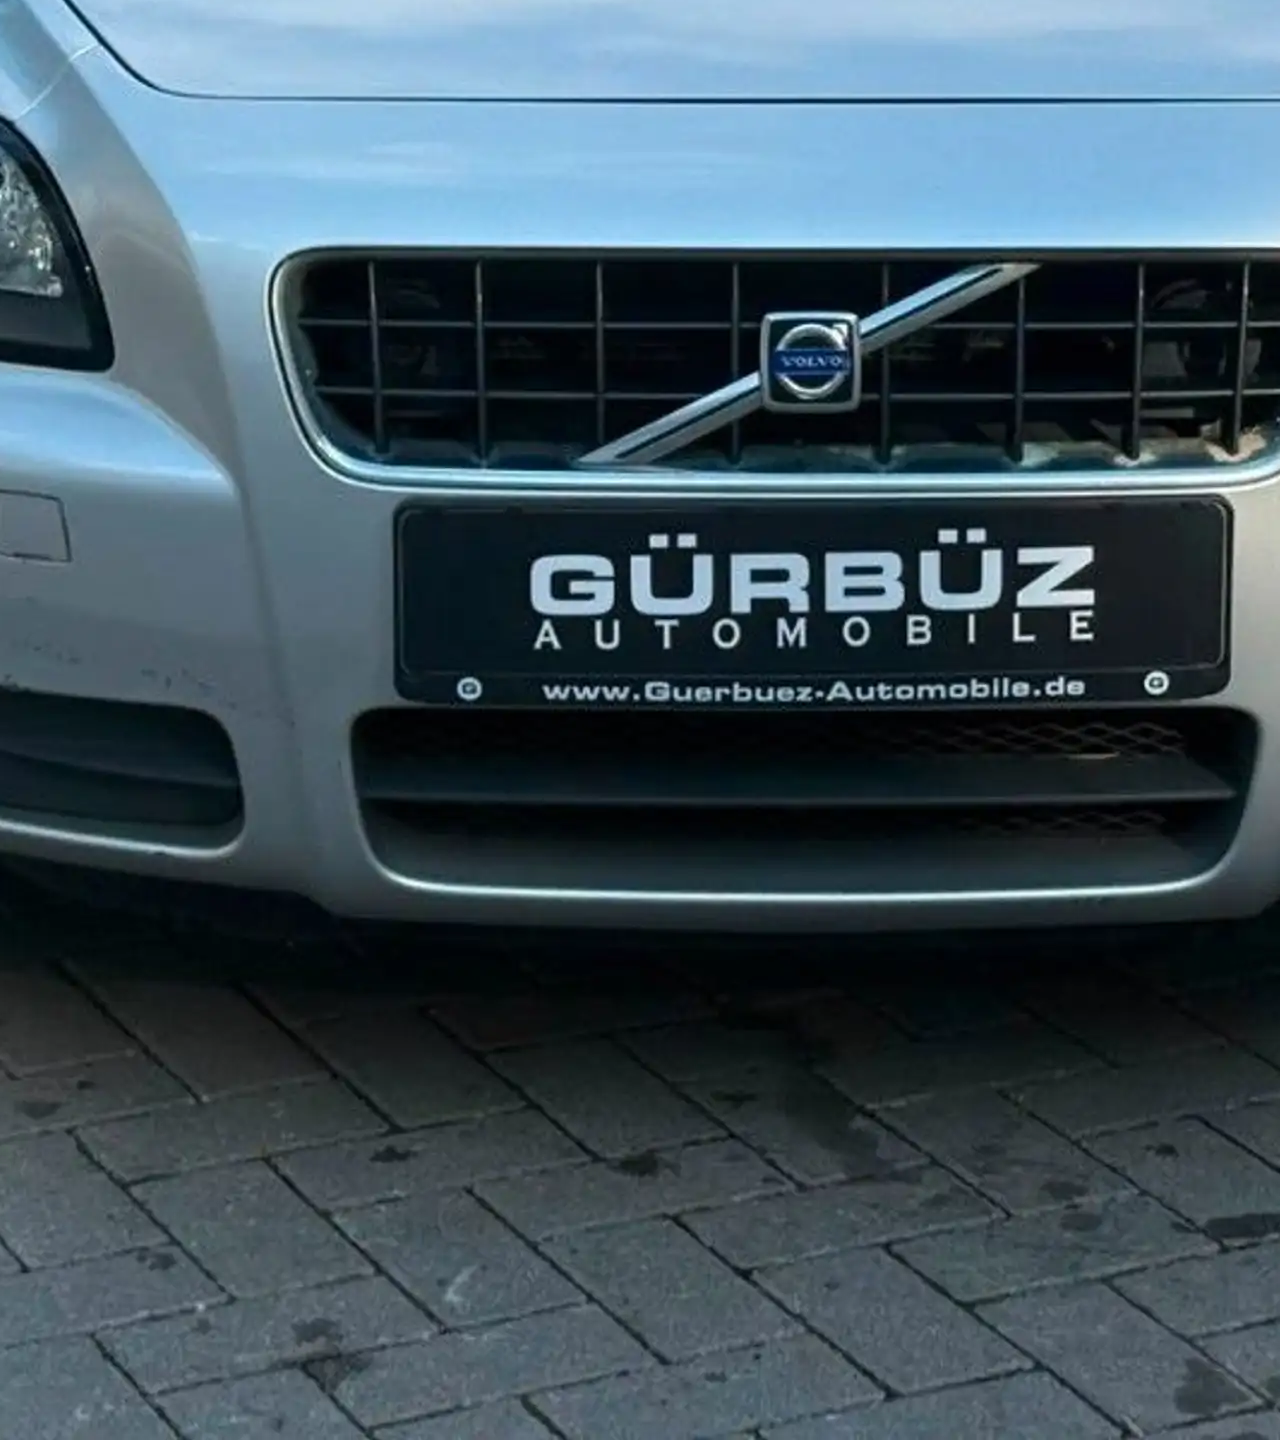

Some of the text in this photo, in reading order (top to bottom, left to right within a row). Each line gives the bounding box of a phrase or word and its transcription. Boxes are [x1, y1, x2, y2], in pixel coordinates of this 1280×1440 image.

[781, 356, 842, 367] VOLVO
[529, 529, 1095, 616] GÜRBÜZ
[533, 610, 1095, 650] AUTOMOBILE
[542, 676, 1087, 704] www.Guerbuez-Automobile.de
